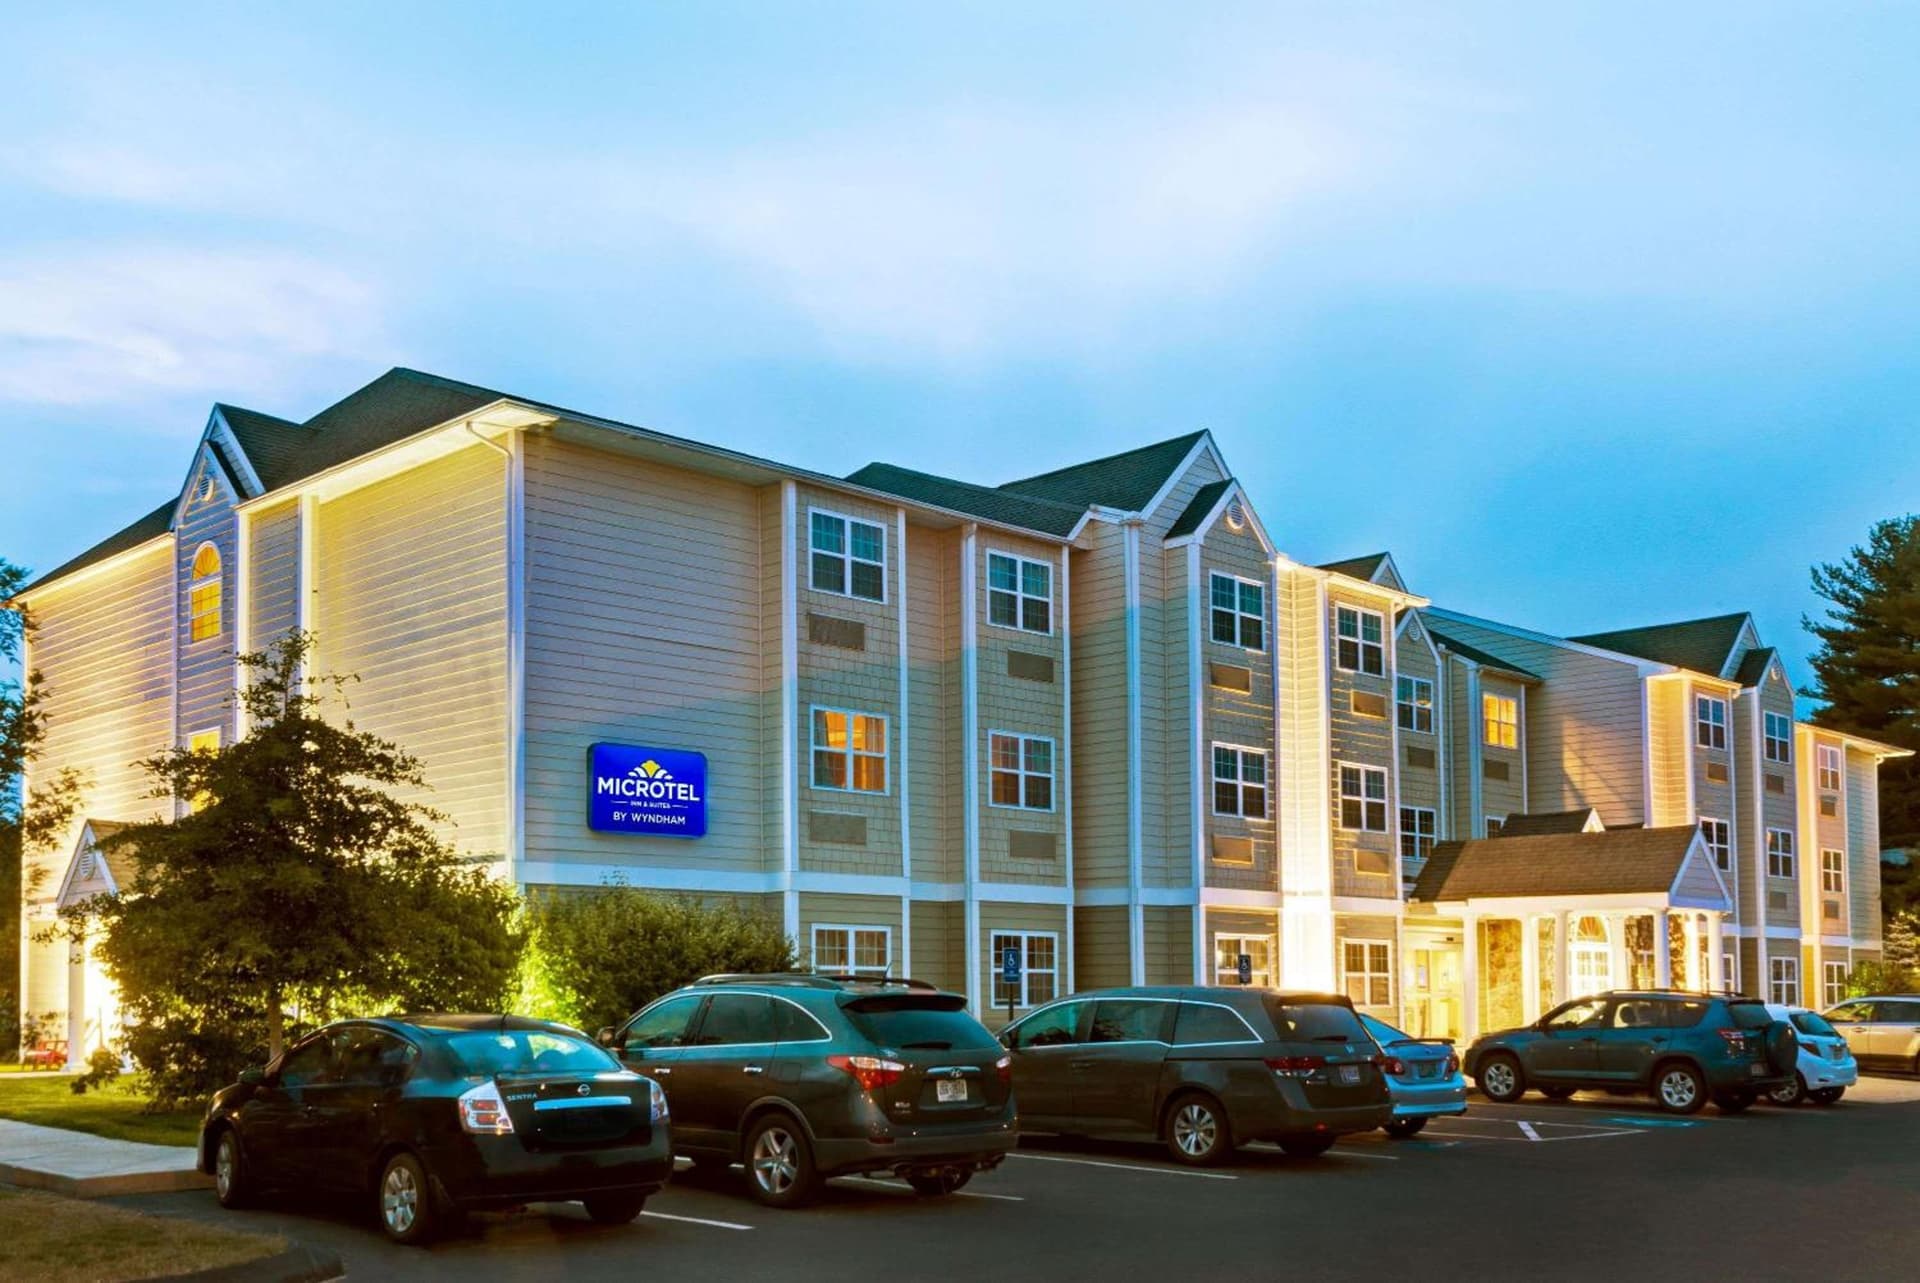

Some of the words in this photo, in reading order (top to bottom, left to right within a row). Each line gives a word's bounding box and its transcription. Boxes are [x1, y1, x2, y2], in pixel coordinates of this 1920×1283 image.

[598, 777, 700, 801] MICROTEL
[613, 811, 627, 821] BY
[631, 812, 686, 825] WYNDHAM
[507, 1094, 537, 1102] SENTRA
